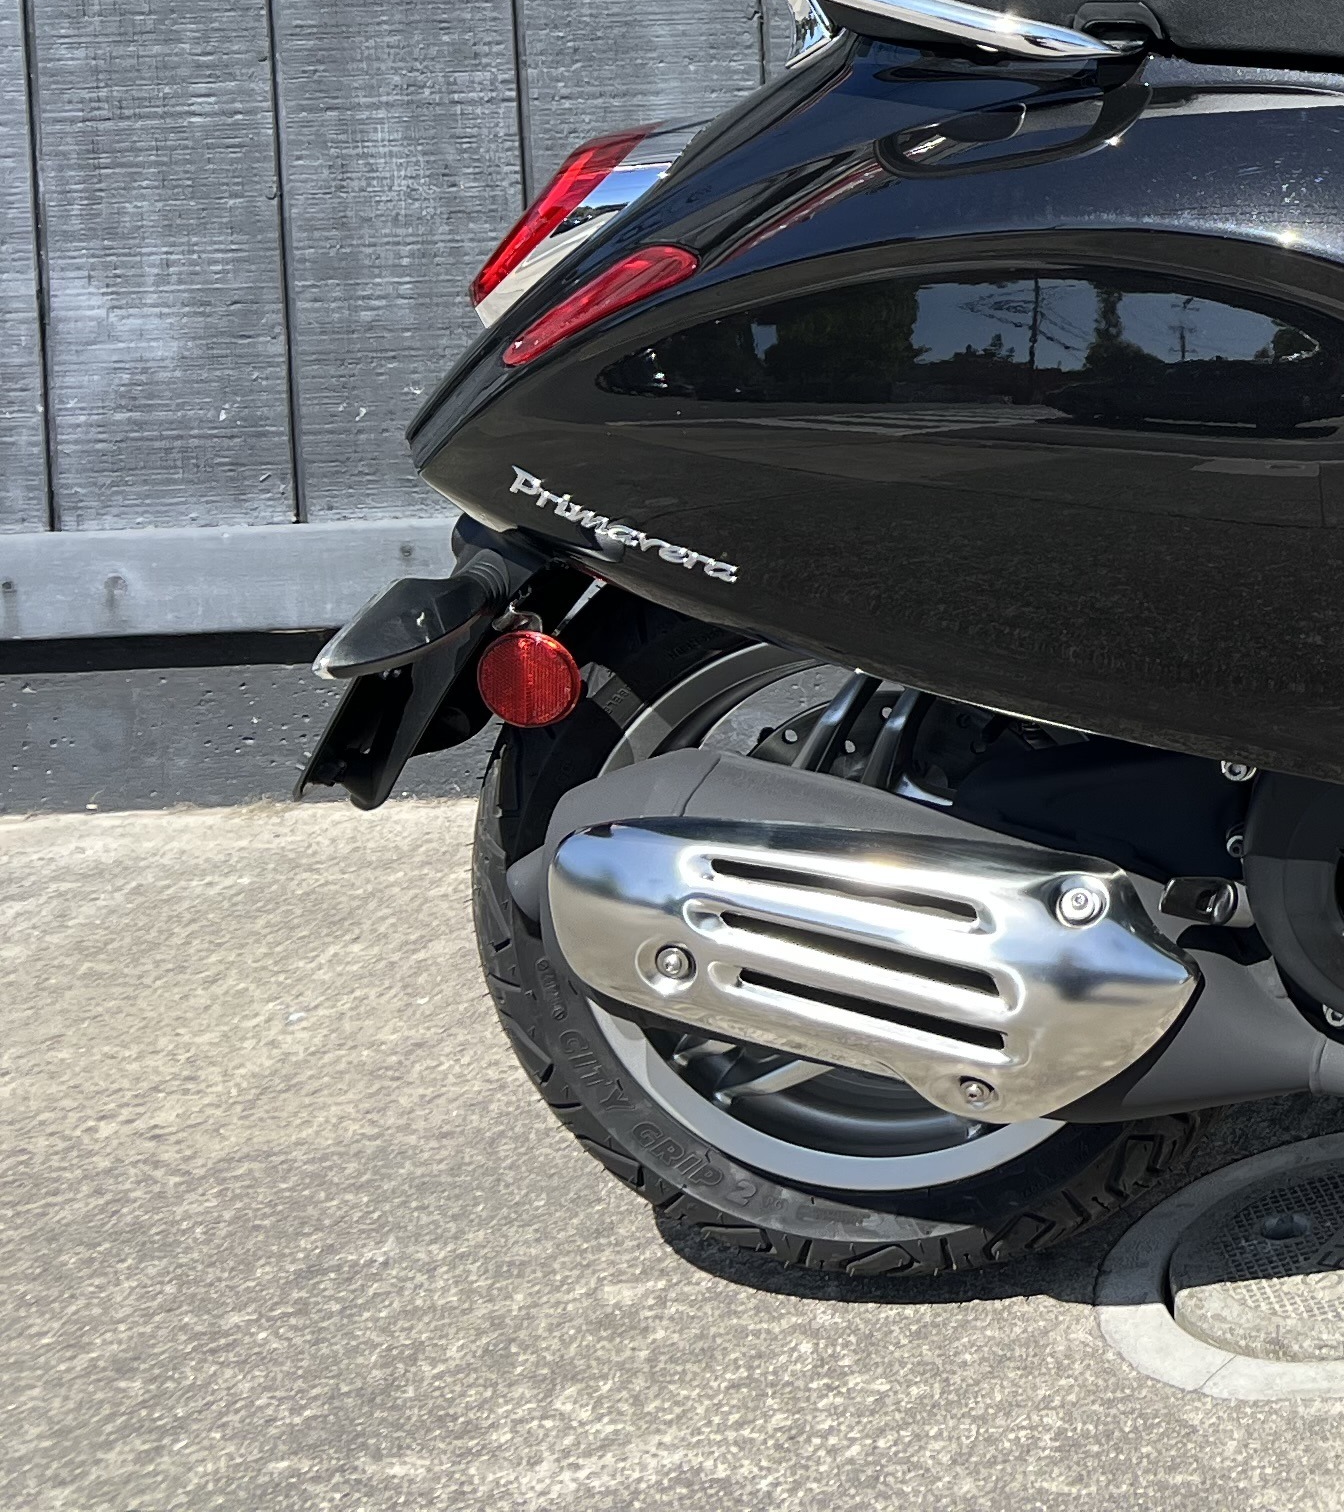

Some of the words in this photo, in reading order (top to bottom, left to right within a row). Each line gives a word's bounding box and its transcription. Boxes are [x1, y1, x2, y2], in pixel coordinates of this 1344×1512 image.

[509, 464, 740, 584] Primavera
[558, 1029, 636, 1112] CITY
[631, 1121, 724, 1186] GRIP
[725, 1179, 757, 1207] 2
